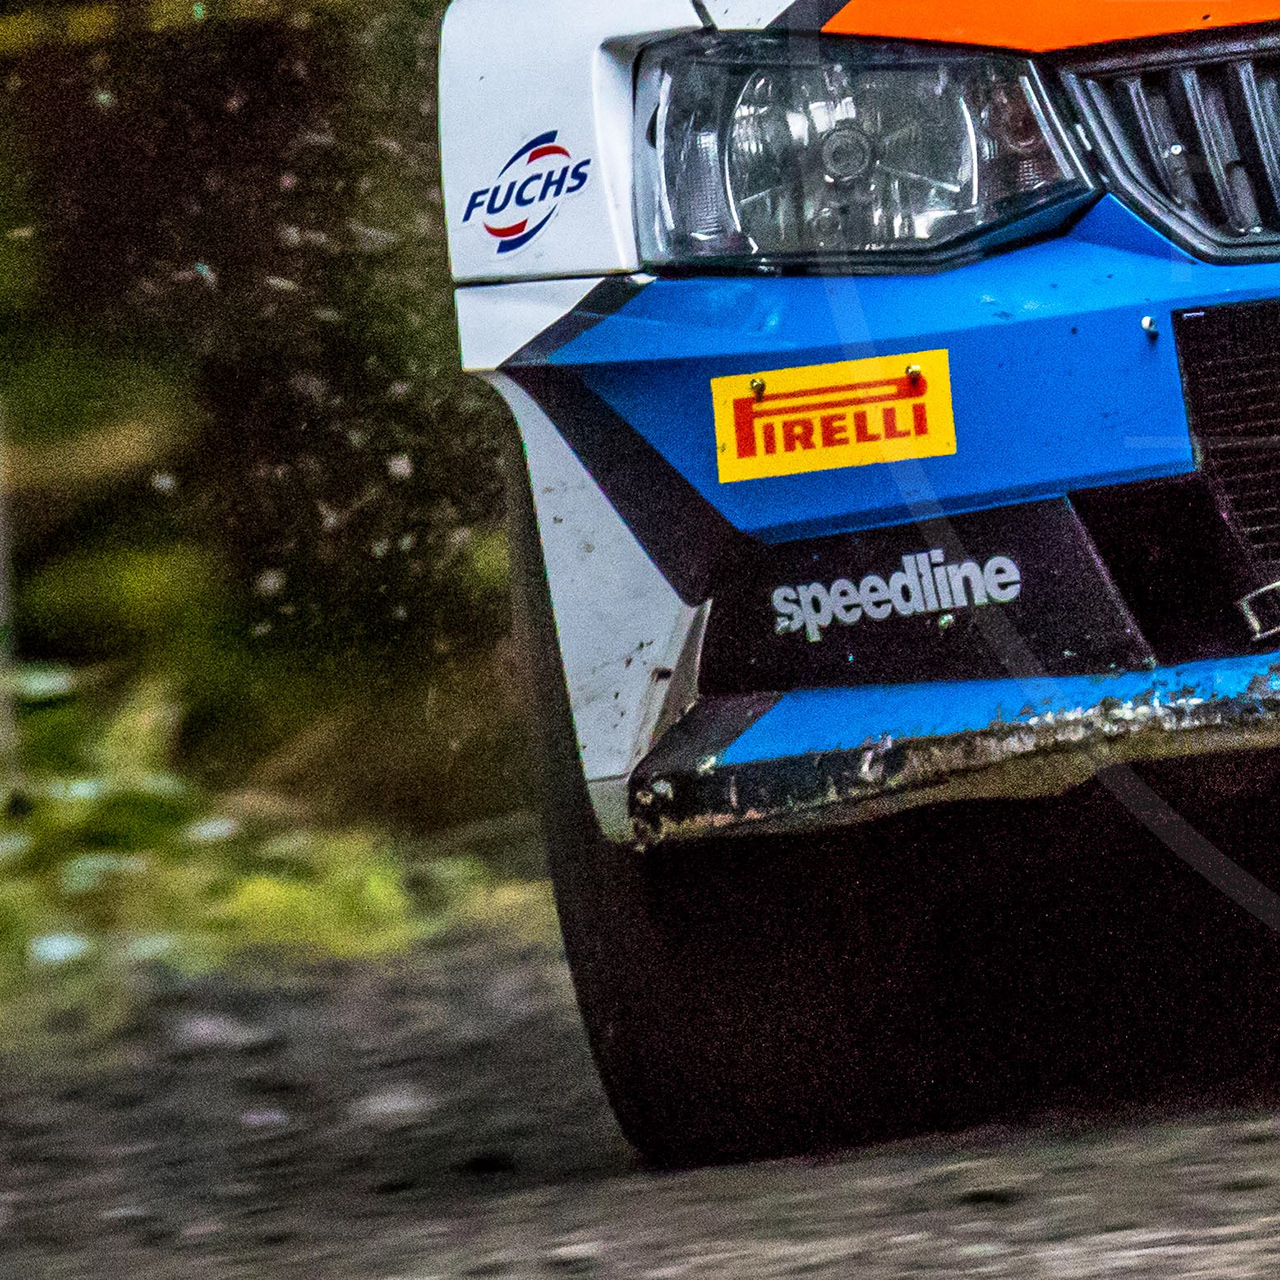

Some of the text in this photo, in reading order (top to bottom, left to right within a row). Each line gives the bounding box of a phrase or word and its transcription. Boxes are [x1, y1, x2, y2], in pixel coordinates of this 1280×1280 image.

[462, 157, 592, 223] FUCHS
[732, 373, 929, 459] PIRELLI
[771, 548, 1022, 642] speedline
